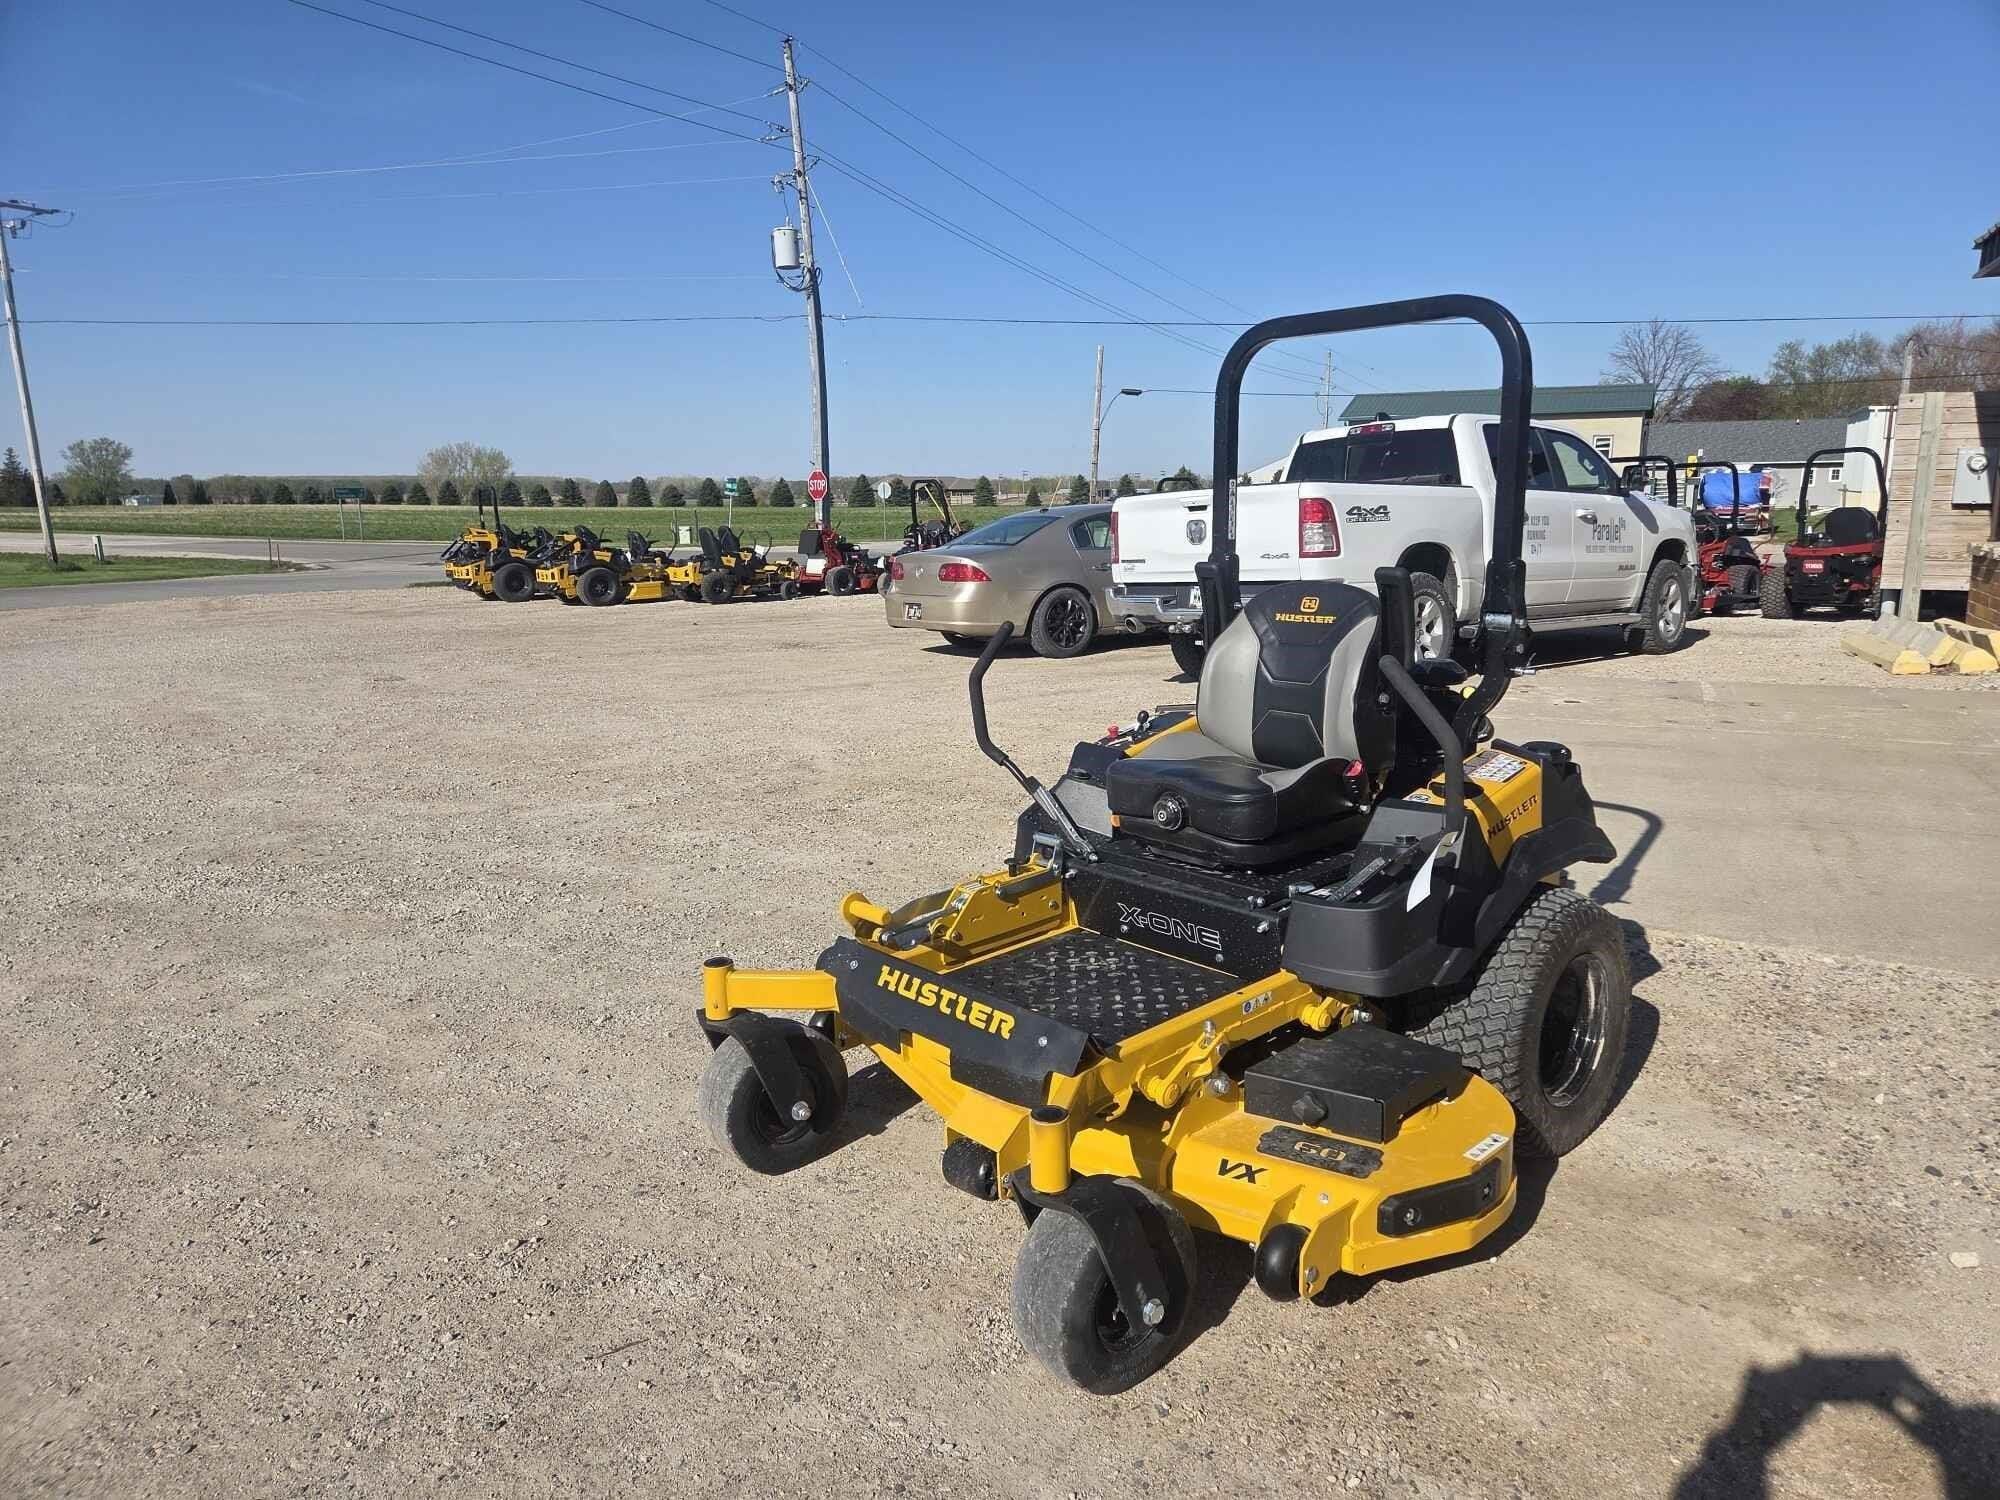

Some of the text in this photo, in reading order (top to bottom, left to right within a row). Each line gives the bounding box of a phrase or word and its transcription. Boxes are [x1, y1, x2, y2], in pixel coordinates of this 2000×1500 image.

[809, 480, 826, 494] STOP
[1592, 517, 1621, 544] Parallel
[1275, 612, 1335, 624] HUSTLER
[1487, 794, 1538, 840] HUSTLER
[1116, 902, 1222, 951] X-ONE
[877, 964, 1016, 1040] HUSTLER
[1294, 1140, 1347, 1162] 60
[1218, 1157, 1269, 1185] VX
